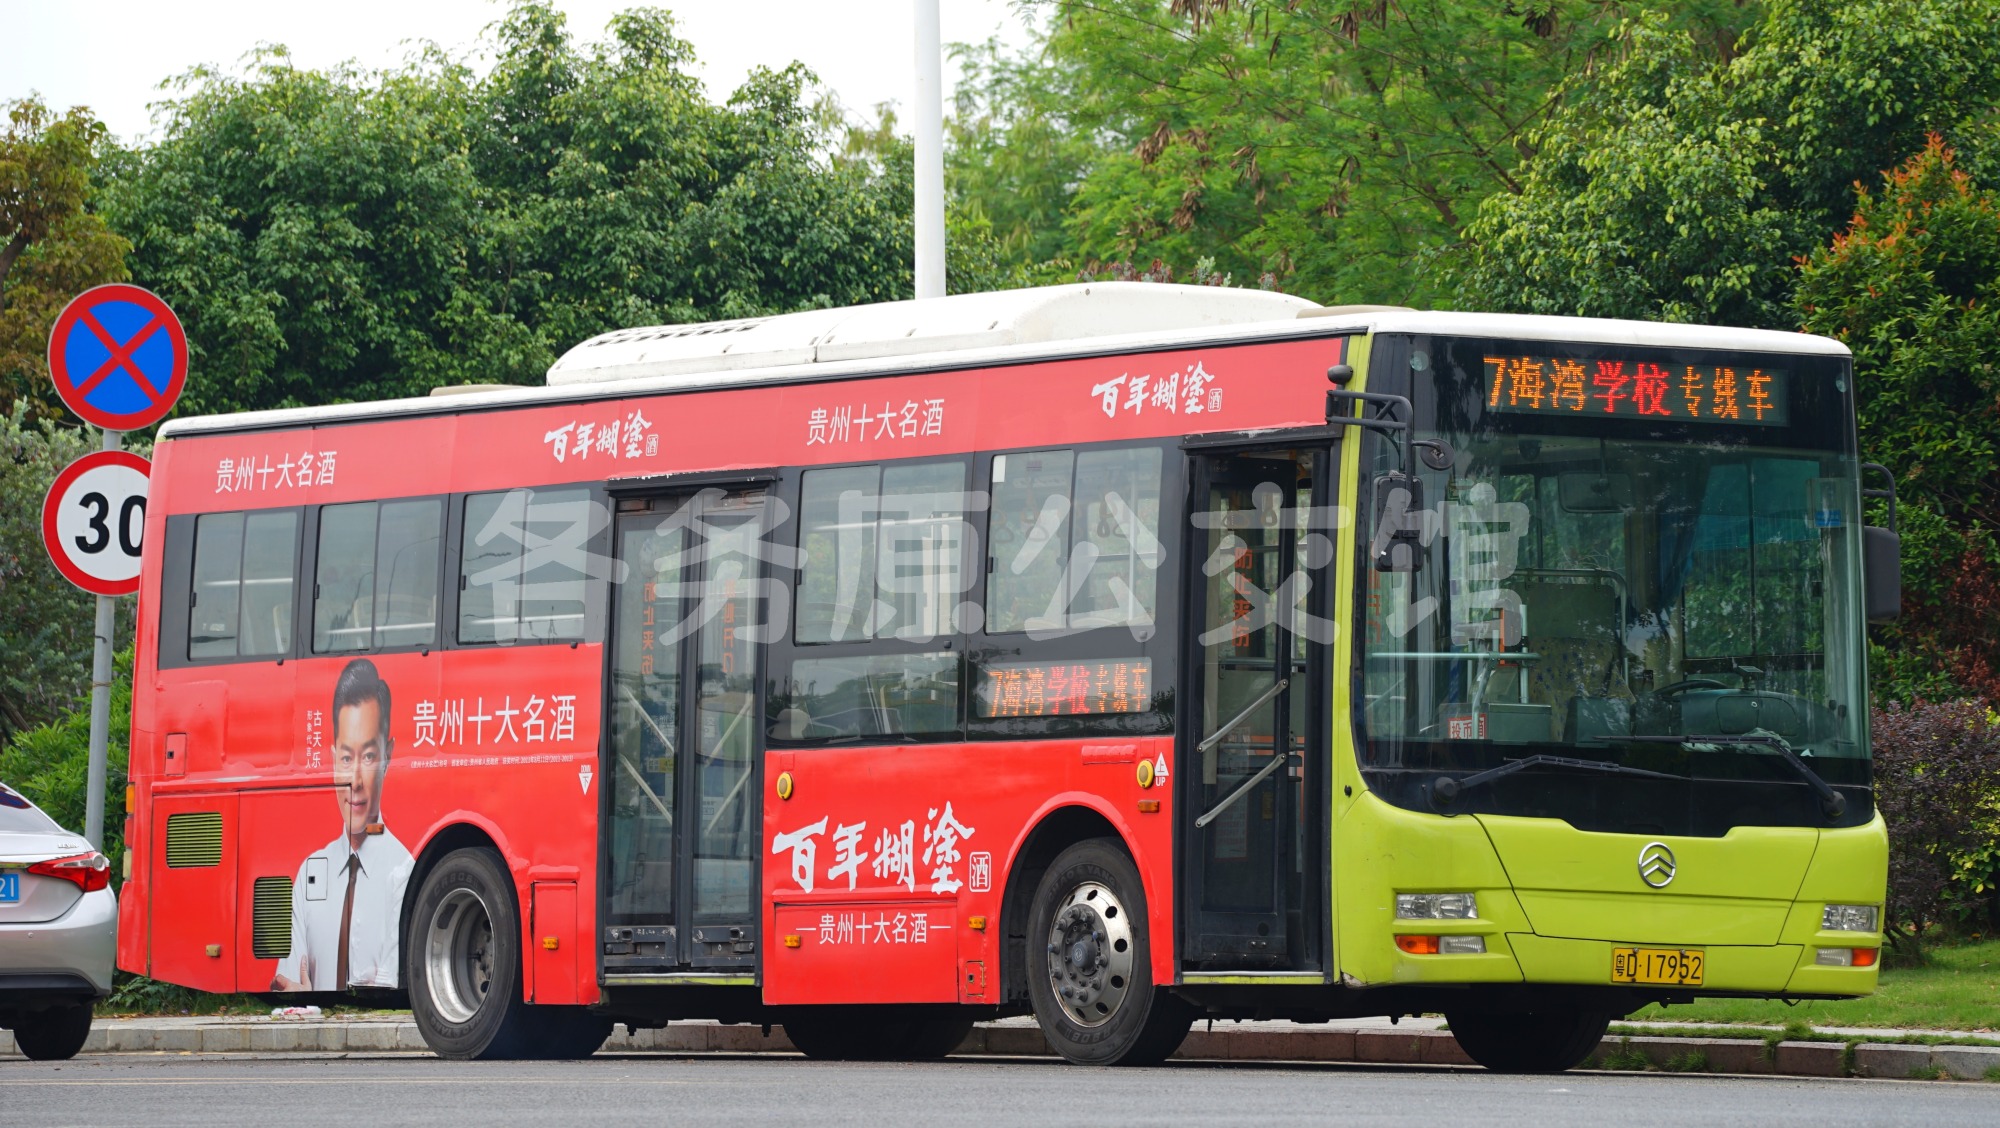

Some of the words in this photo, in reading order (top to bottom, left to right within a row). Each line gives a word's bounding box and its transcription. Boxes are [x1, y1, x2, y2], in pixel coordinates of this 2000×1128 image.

[1483, 357, 1774, 420] 7海湾学校专线车
[806, 398, 944, 446] 贵州十大名酒
[215, 451, 337, 493] 贵州十大名酒
[75, 491, 147, 557] 30
[1231, 547, 1253, 647] 防止夹伤
[312, 709, 322, 769] 古天乐
[413, 694, 576, 748] 贵州十大名酒
[1155, 776, 1166, 787] UP
[1157, 760, 1165, 773] 上
[970, 854, 990, 890] 酒
[818, 912, 928, 945] 贵州十大名酒
